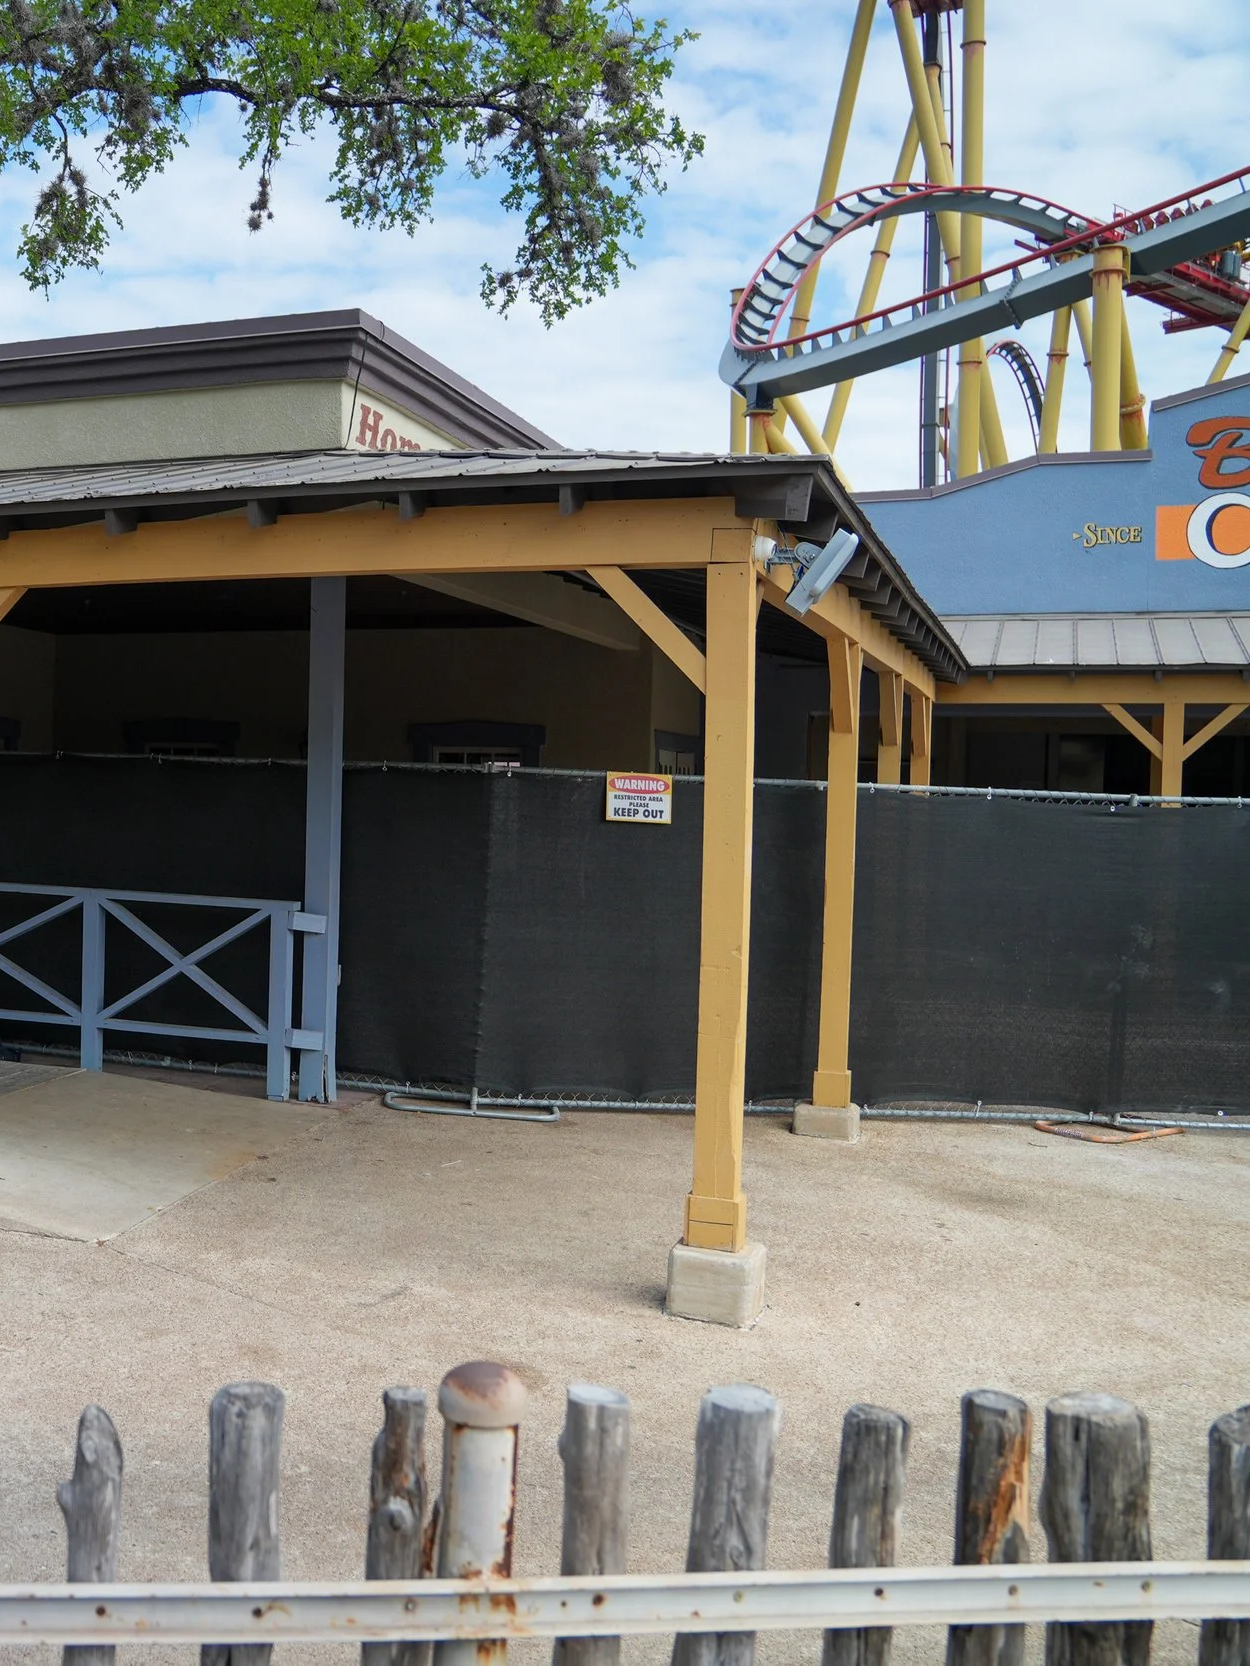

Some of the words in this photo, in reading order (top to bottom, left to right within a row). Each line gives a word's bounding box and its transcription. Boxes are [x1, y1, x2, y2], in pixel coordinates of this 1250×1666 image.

[1083, 522, 1142, 548] SINCE
[614, 778, 665, 791] WARNING
[614, 807, 639, 817] KEEP
[643, 809, 664, 819] OUT
